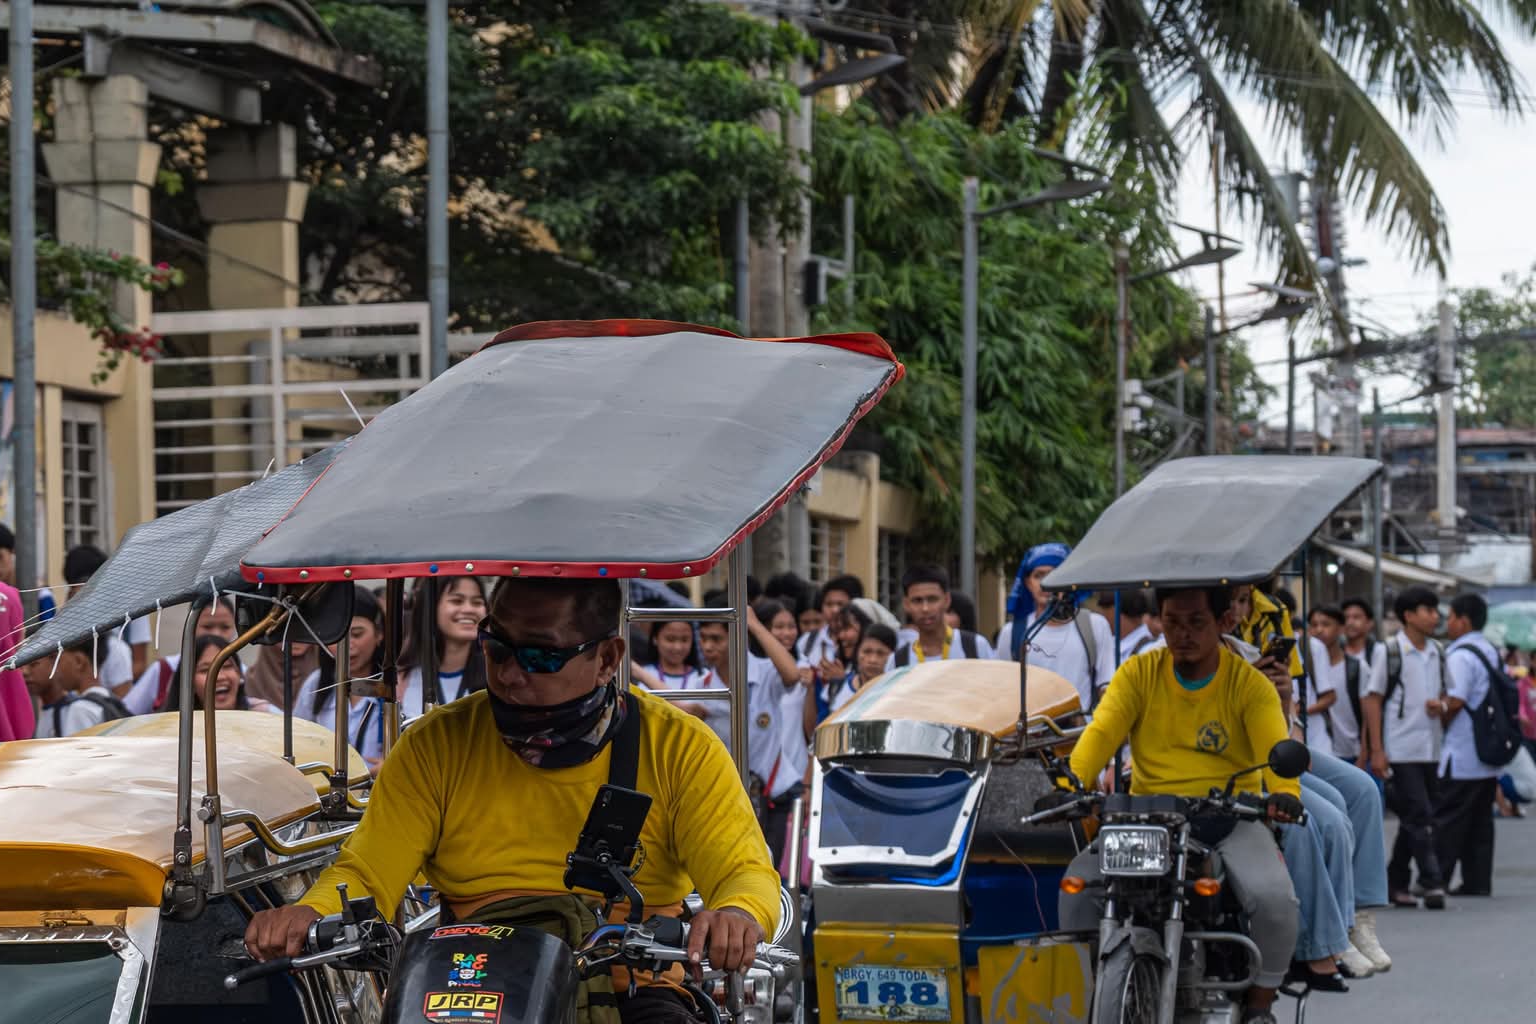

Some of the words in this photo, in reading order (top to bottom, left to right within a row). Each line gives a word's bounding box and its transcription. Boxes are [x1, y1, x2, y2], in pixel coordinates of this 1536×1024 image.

[844, 968, 874, 980] BRGY.
[878, 969, 896, 980] 649
[899, 970, 928, 981] TODA
[847, 981, 939, 1006] 188
[432, 995, 497, 1008] JRP
